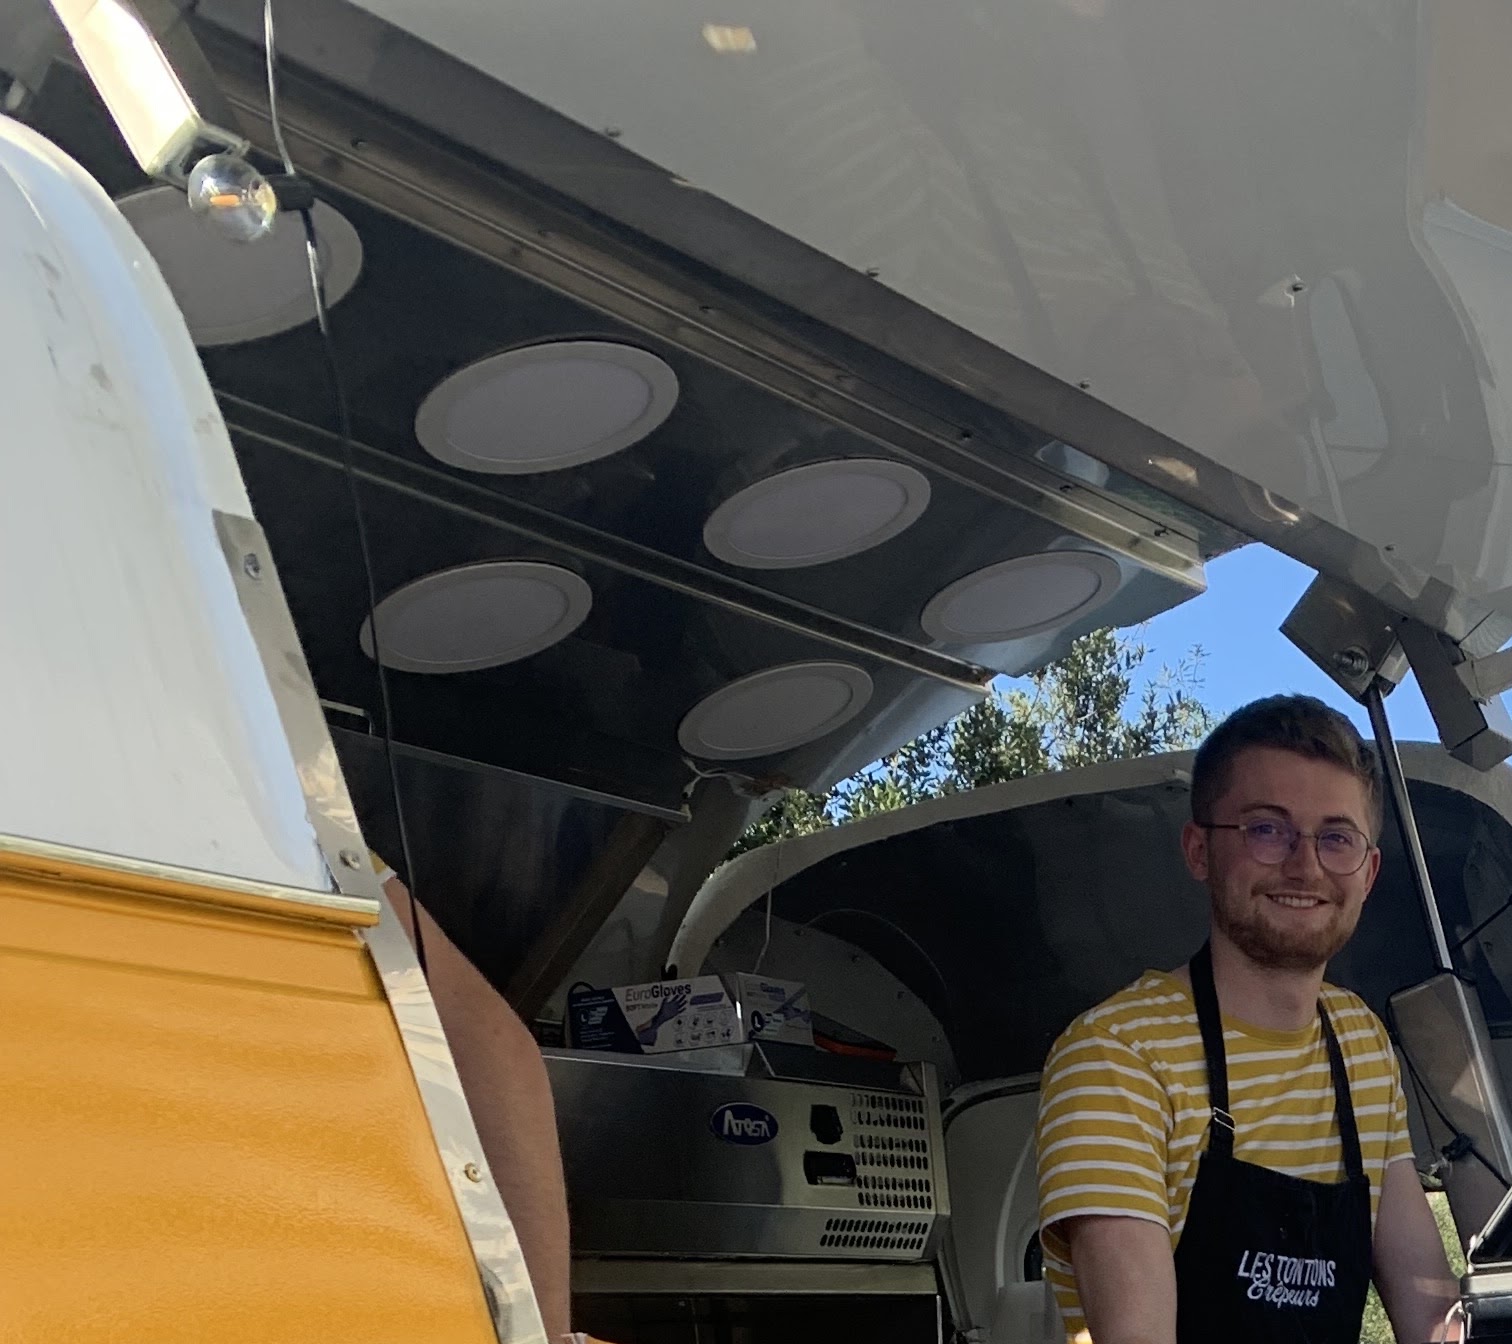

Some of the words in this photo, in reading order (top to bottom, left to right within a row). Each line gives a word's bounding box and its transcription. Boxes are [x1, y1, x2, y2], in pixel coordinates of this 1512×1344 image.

[625, 982, 692, 1003] EuroGloves
[1238, 1250, 1275, 1284] LES
[1277, 1255, 1337, 1287] TONTONS
